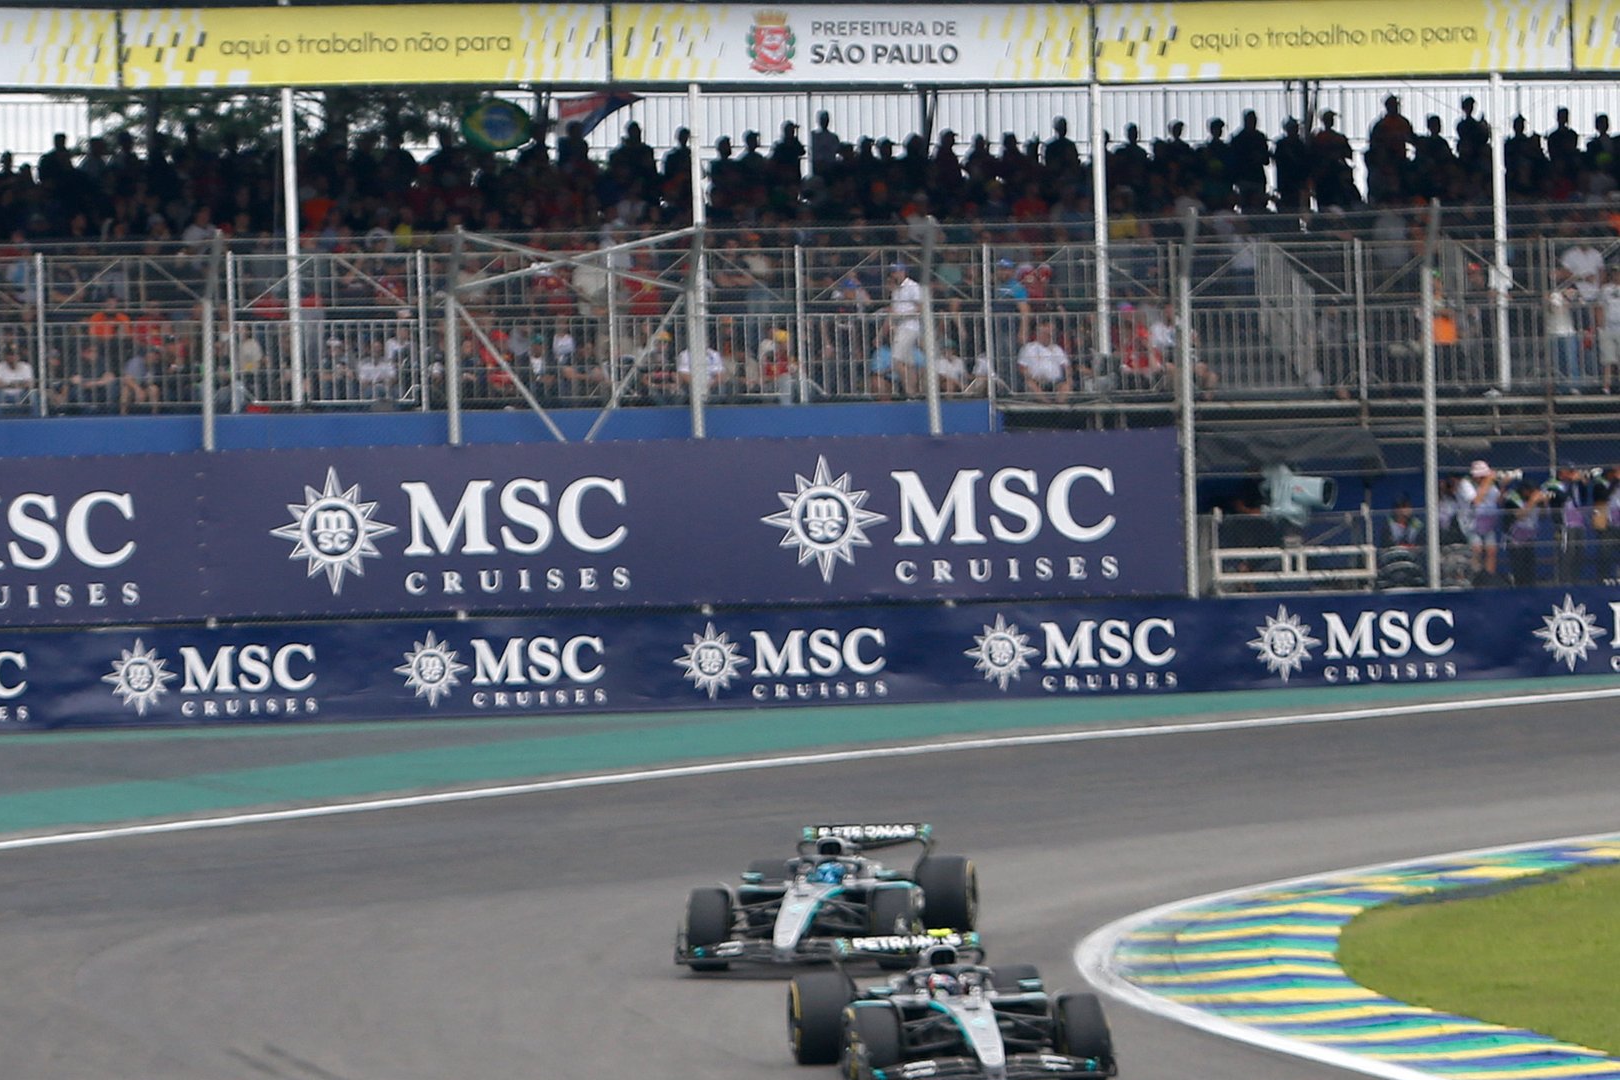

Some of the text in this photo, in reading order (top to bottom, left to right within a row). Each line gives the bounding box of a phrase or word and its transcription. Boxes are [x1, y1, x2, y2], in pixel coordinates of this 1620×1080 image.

[811, 21, 957, 36] PREFEITURA DE
[1190, 24, 1477, 54] aqui o trabalho não para
[220, 32, 511, 59] aqui o trabalho não para
[811, 40, 959, 64] SÃO PAULO
[400, 476, 627, 556] MSC
[890, 466, 1116, 545] MSC
[405, 566, 630, 594] CRUISES
[895, 555, 1119, 584] CRUISES
[1039, 618, 1176, 669] MSC
[1322, 608, 1455, 659] MSC
[470, 635, 604, 685] MSC
[750, 627, 885, 677] MSC
[179, 643, 316, 694] MSC
[1042, 672, 1177, 691] CRUISES
[1324, 661, 1457, 682] CRUISES
[472, 688, 606, 707] CRUISES
[752, 680, 888, 699] CRUISES
[181, 697, 317, 716] CRUISES
[852, 932, 962, 951] PETRONS
